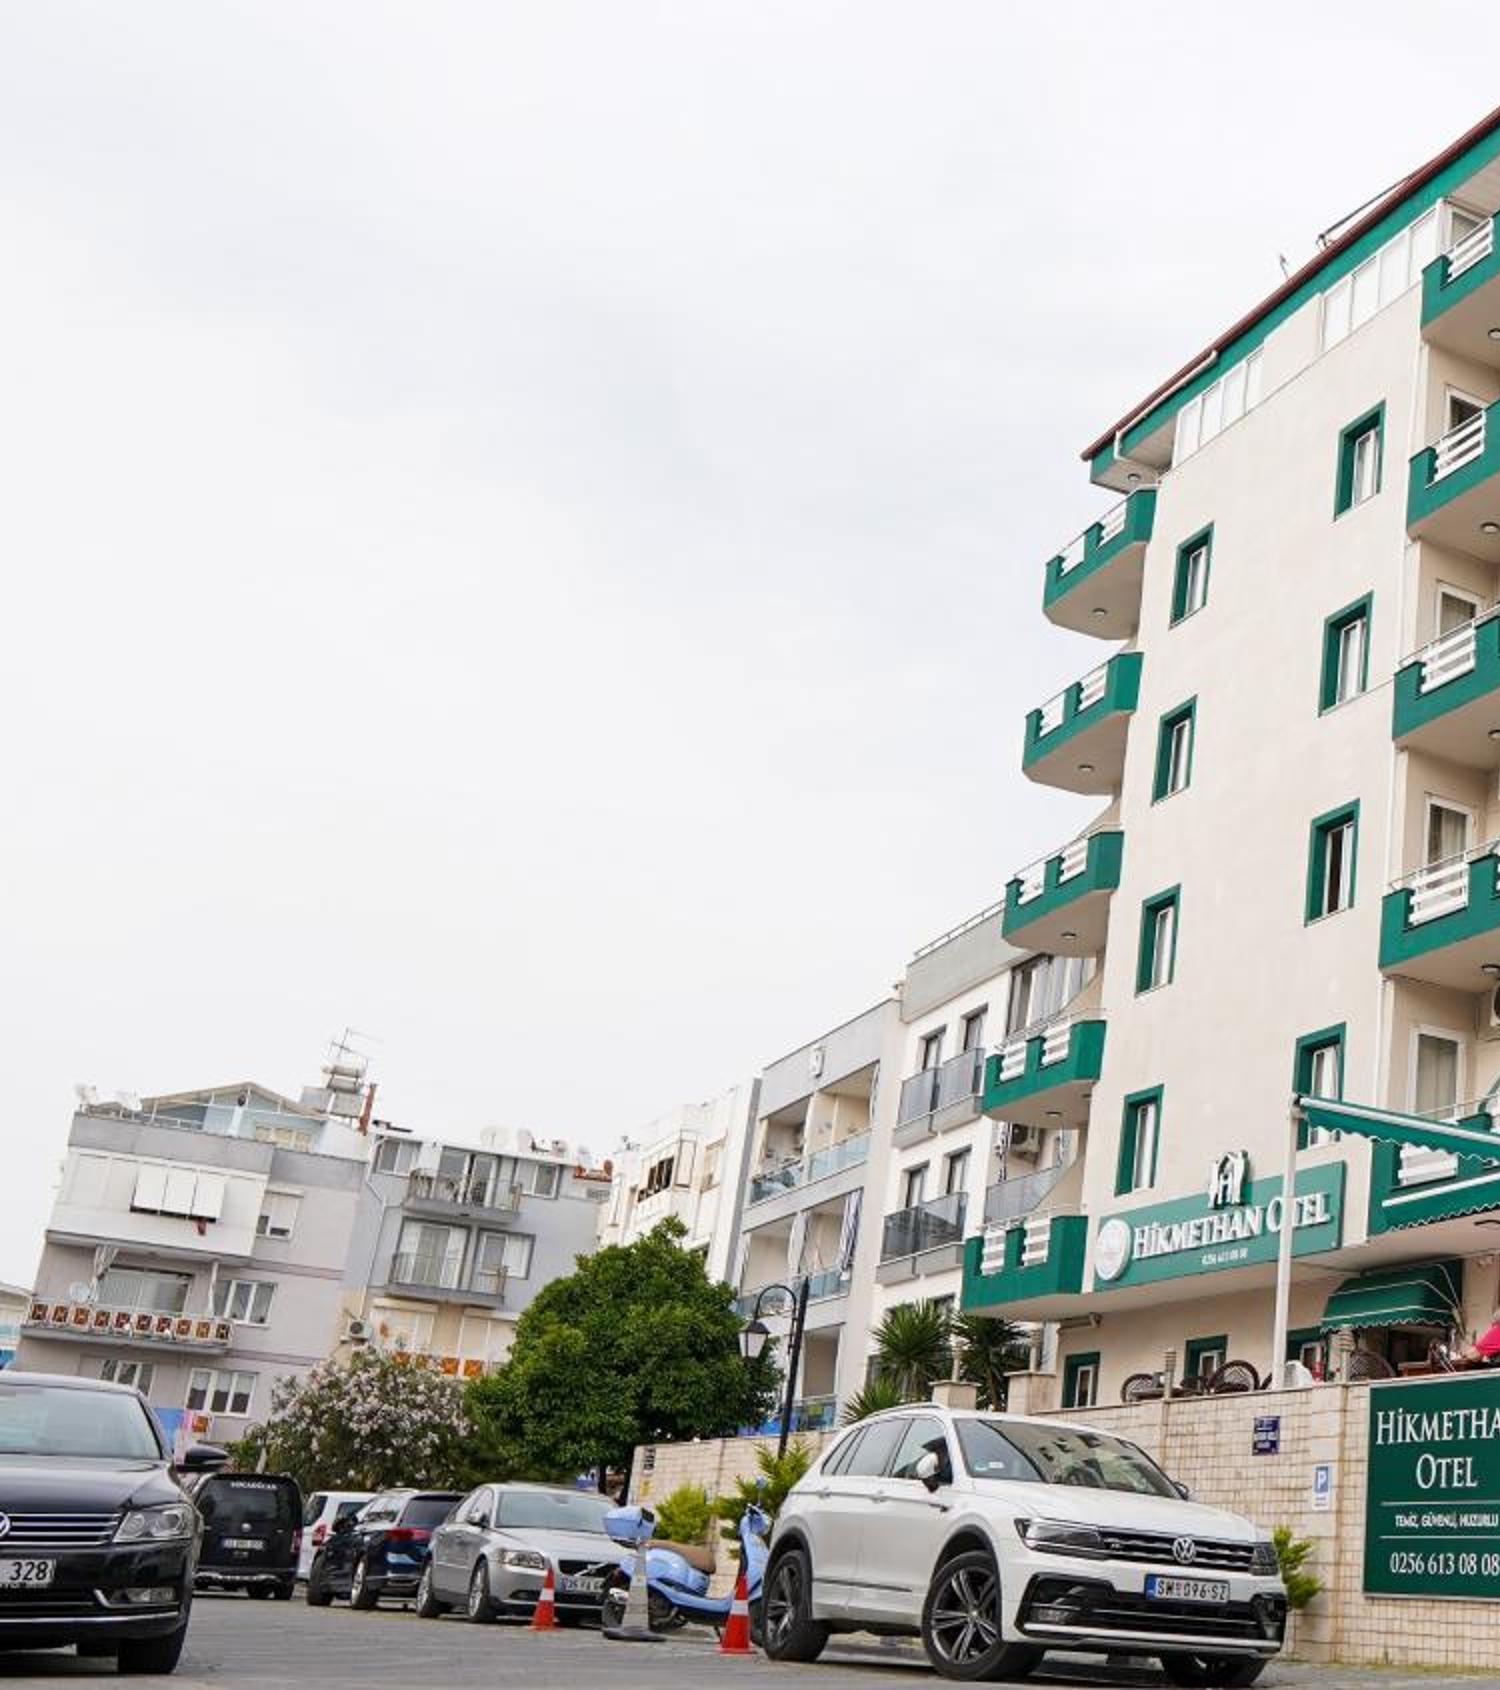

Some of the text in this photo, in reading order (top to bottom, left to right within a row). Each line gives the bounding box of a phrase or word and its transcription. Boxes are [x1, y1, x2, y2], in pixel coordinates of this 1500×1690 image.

[1415, 1453, 1478, 1489] OTEL
[1459, 1513, 1499, 1528] HUZURLU
[10, 1561, 49, 1581] 328
[1390, 1552, 1500, 1576] 0256 613 08 08
